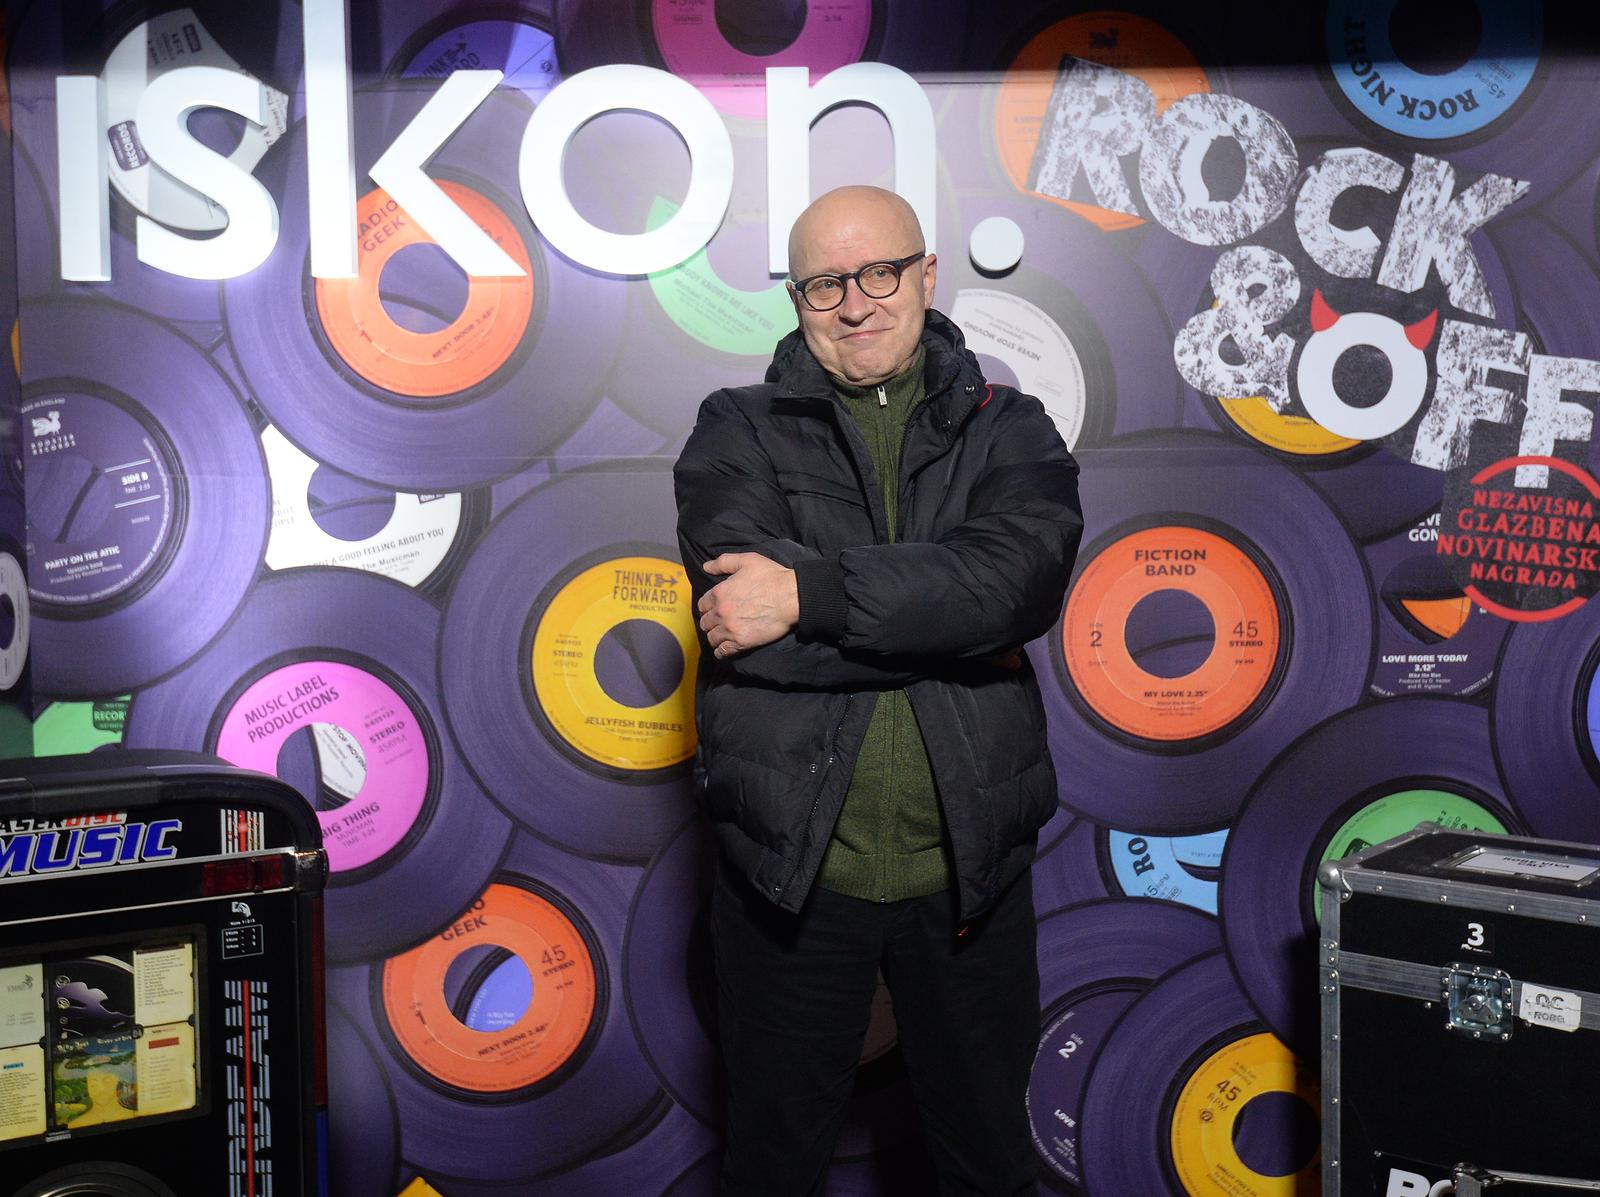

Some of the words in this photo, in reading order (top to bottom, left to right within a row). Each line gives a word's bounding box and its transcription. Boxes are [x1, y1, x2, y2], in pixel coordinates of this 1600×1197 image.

[1397, 88, 1480, 121] ROCK
[1034, 56, 1531, 319] ROCK
[355, 199, 399, 242] ADIO
[362, 215, 407, 253] GEEK
[963, 321, 996, 340] MOVING
[1174, 245, 1301, 415] &
[996, 336, 1016, 351] STOP
[1017, 345, 1042, 362] NEVER
[1297, 295, 1600, 488] OFF
[1473, 489, 1593, 518] NEZAVISNA
[1457, 508, 1600, 545] GLAZBENA
[339, 550, 363, 564] GOOD
[362, 539, 397, 558] FEELING
[397, 532, 425, 550] ABOUT
[426, 527, 445, 540] YOU
[1134, 549, 1207, 562] FICTION
[1436, 534, 1600, 571] NOVINARSK
[45, 556, 69, 571] PARTY
[69, 554, 84, 566] ON
[84, 551, 99, 563] THE
[99, 546, 120, 559] ATTIC
[614, 569, 653, 588] THINK
[1145, 564, 1197, 577] BAND
[1470, 562, 1576, 590] NAGRADA
[612, 586, 678, 605] FORWARD
[629, 604, 677, 613] PRODUCTIONS
[1090, 631, 1103, 648] 2
[1232, 620, 1259, 638] 45
[552, 650, 584, 659] STEREO
[1382, 654, 1406, 663] LOVE
[1408, 654, 1435, 663] MORE
[1437, 654, 1468, 662] TODAY
[244, 694, 287, 726] MUSIC
[288, 674, 328, 704] LABEL
[1161, 690, 1185, 698] LOVE
[94, 710, 127, 721] RECOR
[247, 686, 341, 744] PRODUCTIONS
[585, 716, 635, 729] JELLYFISH
[638, 719, 683, 733] BUBBLES
[369, 720, 406, 745] STEREO
[342, 801, 381, 829] THING
[0, 819, 182, 877] MUSIC
[1128, 837, 1155, 877] RO
[1541, 859, 1571, 869] VIVA
[440, 914, 488, 942] GEEK
[1467, 923, 1484, 946] 3
[541, 944, 567, 966] 45
[543, 959, 576, 978] STEREO
[478, 1043, 500, 1057] NEXT
[1057, 1040, 1078, 1059] 2
[1216, 1079, 1242, 1102] 45
[1206, 1092, 1230, 1113] RPM
[1054, 1108, 1077, 1128] LOVE
